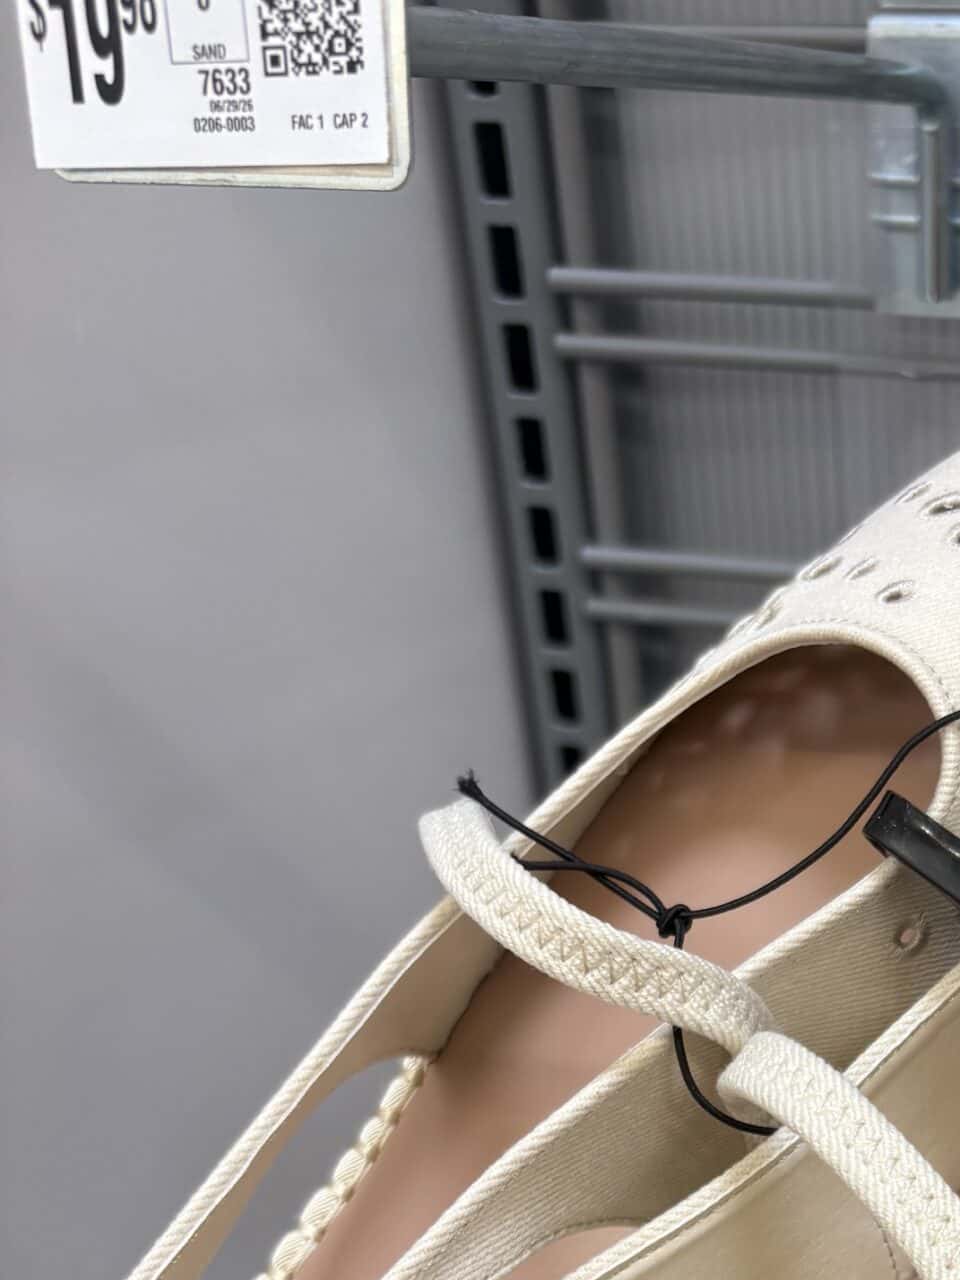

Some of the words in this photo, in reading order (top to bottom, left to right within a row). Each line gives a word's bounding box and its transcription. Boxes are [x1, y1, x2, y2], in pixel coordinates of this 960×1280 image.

[192, 44, 227, 61] SAND
[197, 67, 251, 97] 7633
[209, 98, 254, 113] 06/29/26
[193, 116, 256, 133] 0206-0003
[291, 114, 314, 130] FAC
[317, 113, 325, 129] 1
[332, 112, 357, 129] CAP
[361, 112, 369, 128] 2
